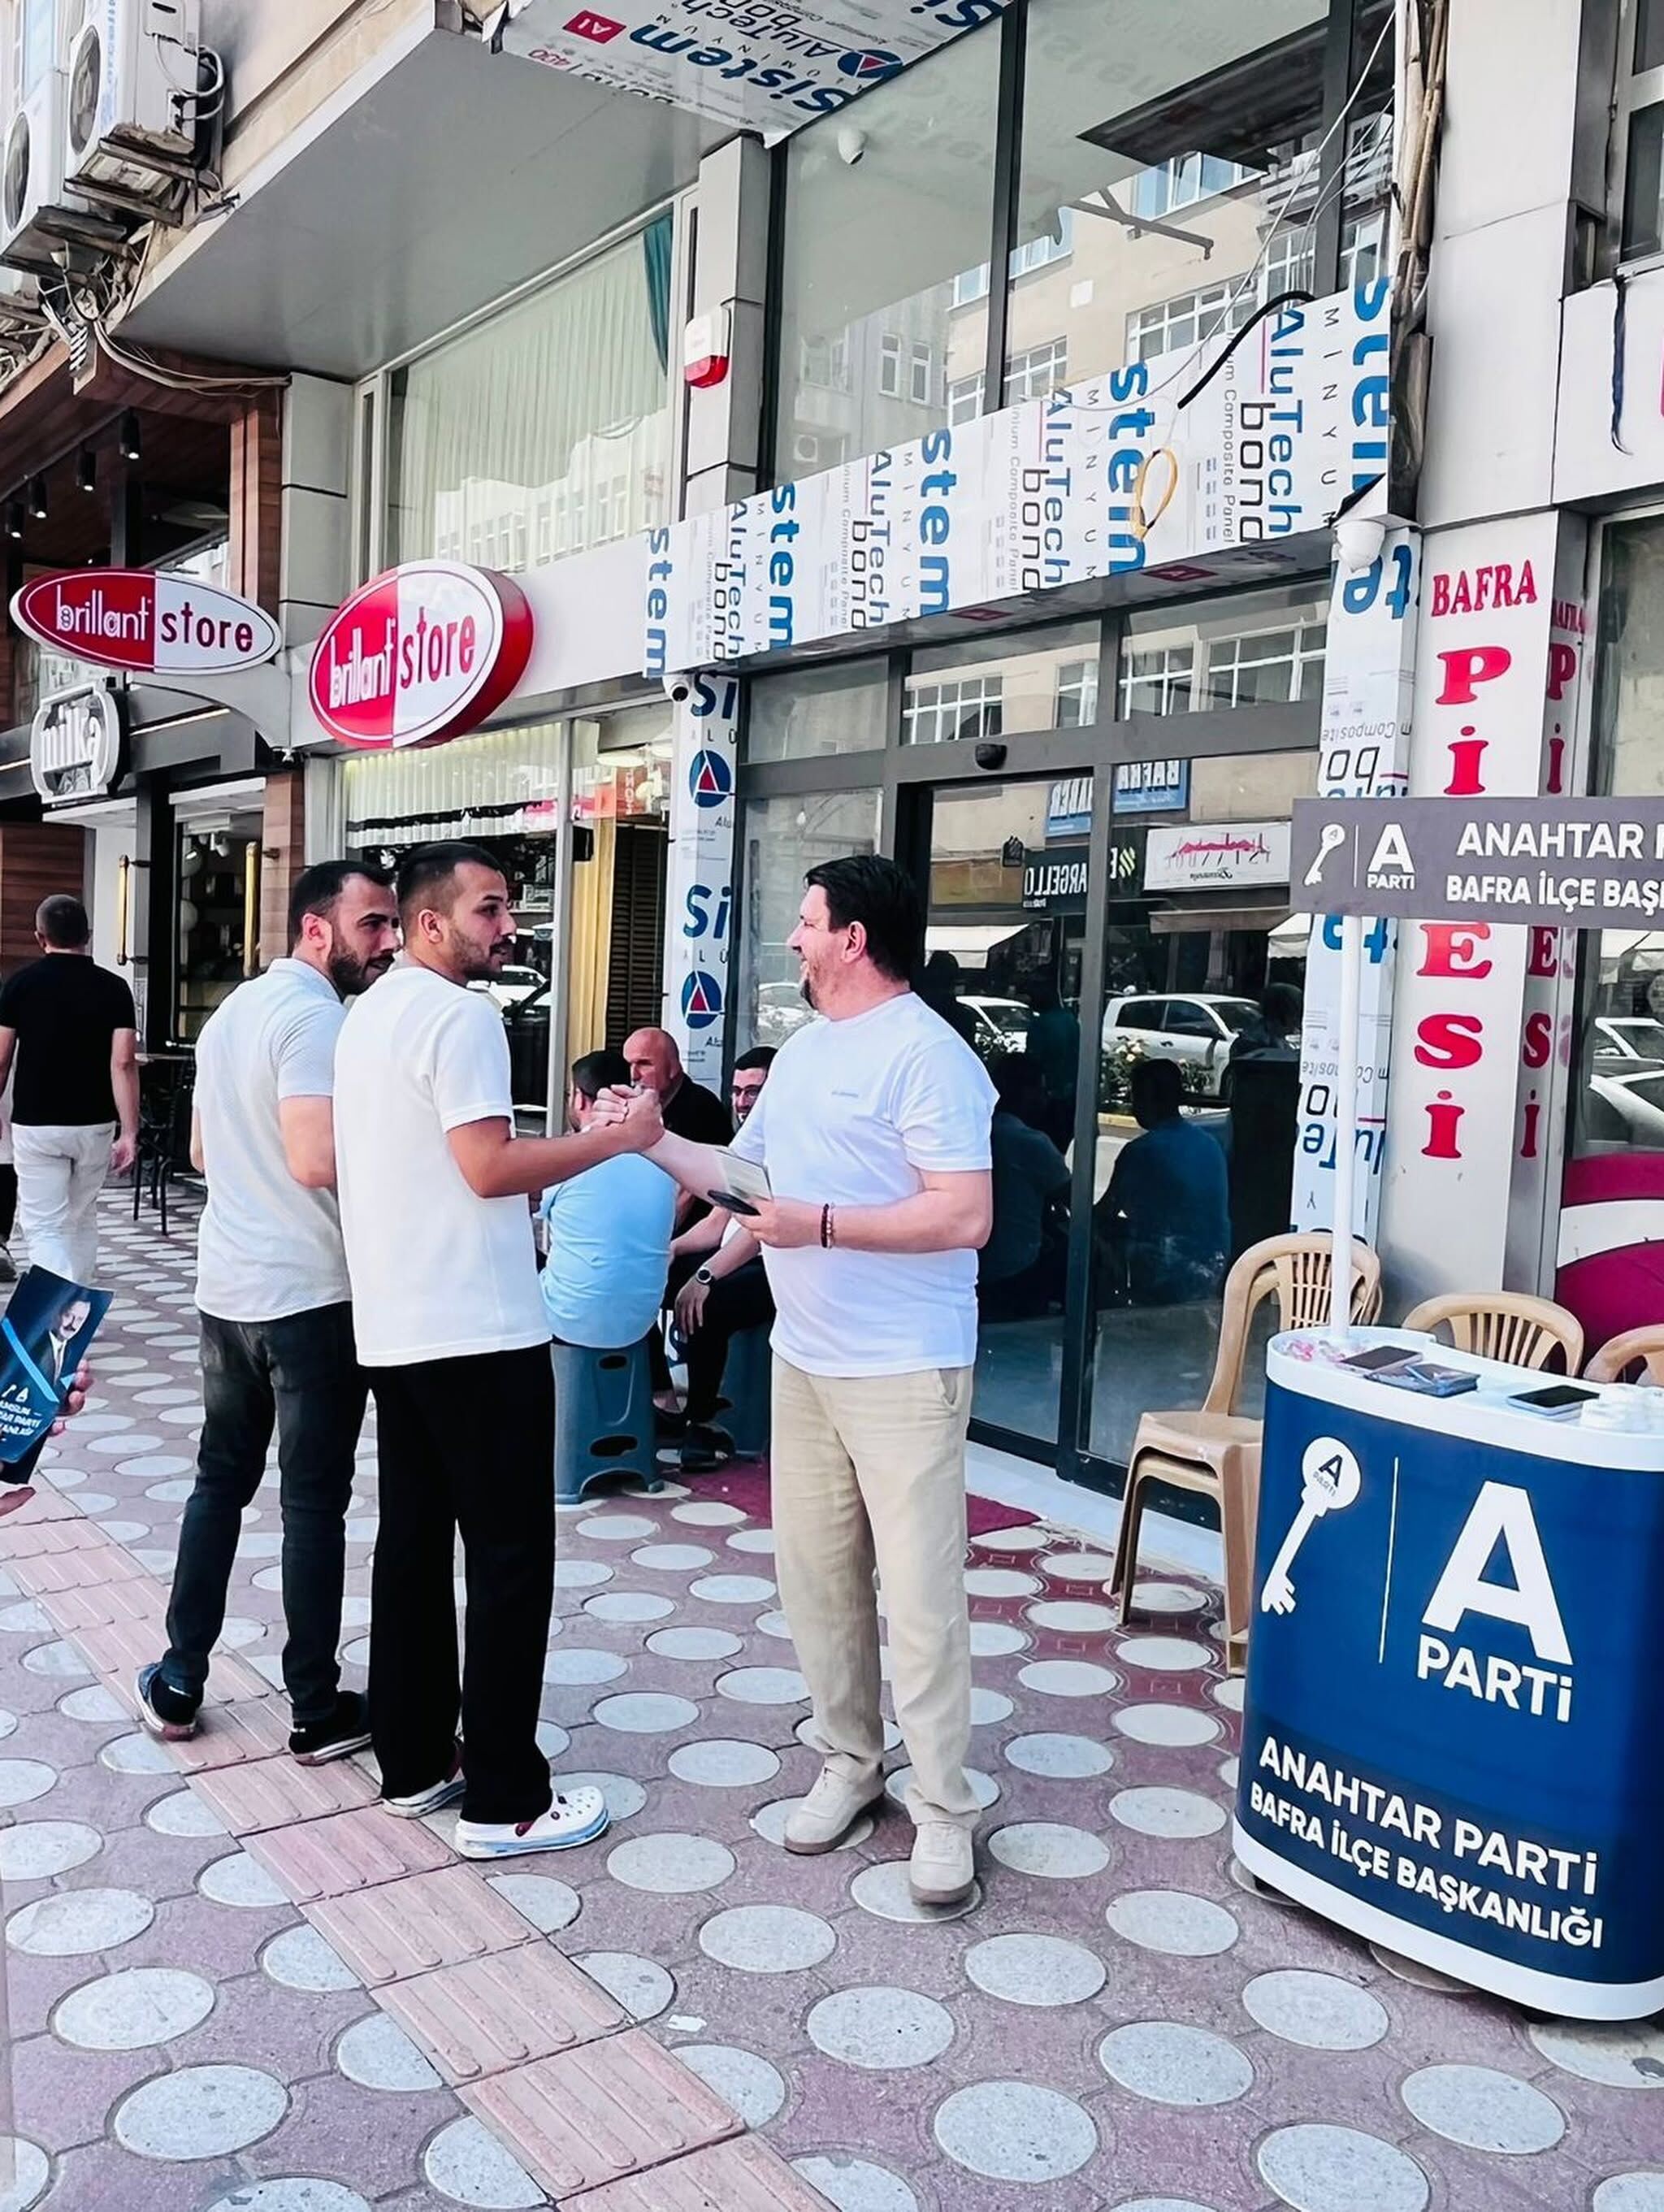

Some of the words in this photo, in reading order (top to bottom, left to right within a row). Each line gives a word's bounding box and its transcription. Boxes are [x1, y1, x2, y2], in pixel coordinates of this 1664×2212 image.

[630, 23, 853, 112] Sistem
[681, 0, 843, 58] AluTech
[1268, 309, 1305, 533] AluTech
[869, 450, 891, 624] AluTech
[920, 428, 957, 616] stem
[1044, 388, 1072, 583] AluTech
[55, 585, 150, 641] brillant
[161, 601, 253, 652] store
[728, 501, 748, 655] AluTech
[1432, 560, 1538, 618] BAFRA
[329, 616, 396, 709] brillant
[400, 606, 476, 689] store
[1367, 823, 1415, 873] A
[1455, 822, 1644, 860] ANAHTAR
[1446, 874, 1532, 905] BAFRA
[1538, 870, 1596, 913] İLÇE
[1602, 878, 1664, 917] BAŞ
[1318, 1454, 1343, 1488] A
[1421, 1480, 1574, 1665] A
[1250, 1780, 1325, 1850] BAFRA
[1330, 1819, 1391, 1880] İLÇE
[1396, 1854, 1604, 1949] BAŞKANLIĞI
[1259, 1736, 1442, 1850] ANAHTAR
[1453, 1818, 1598, 1896] PARTİ
